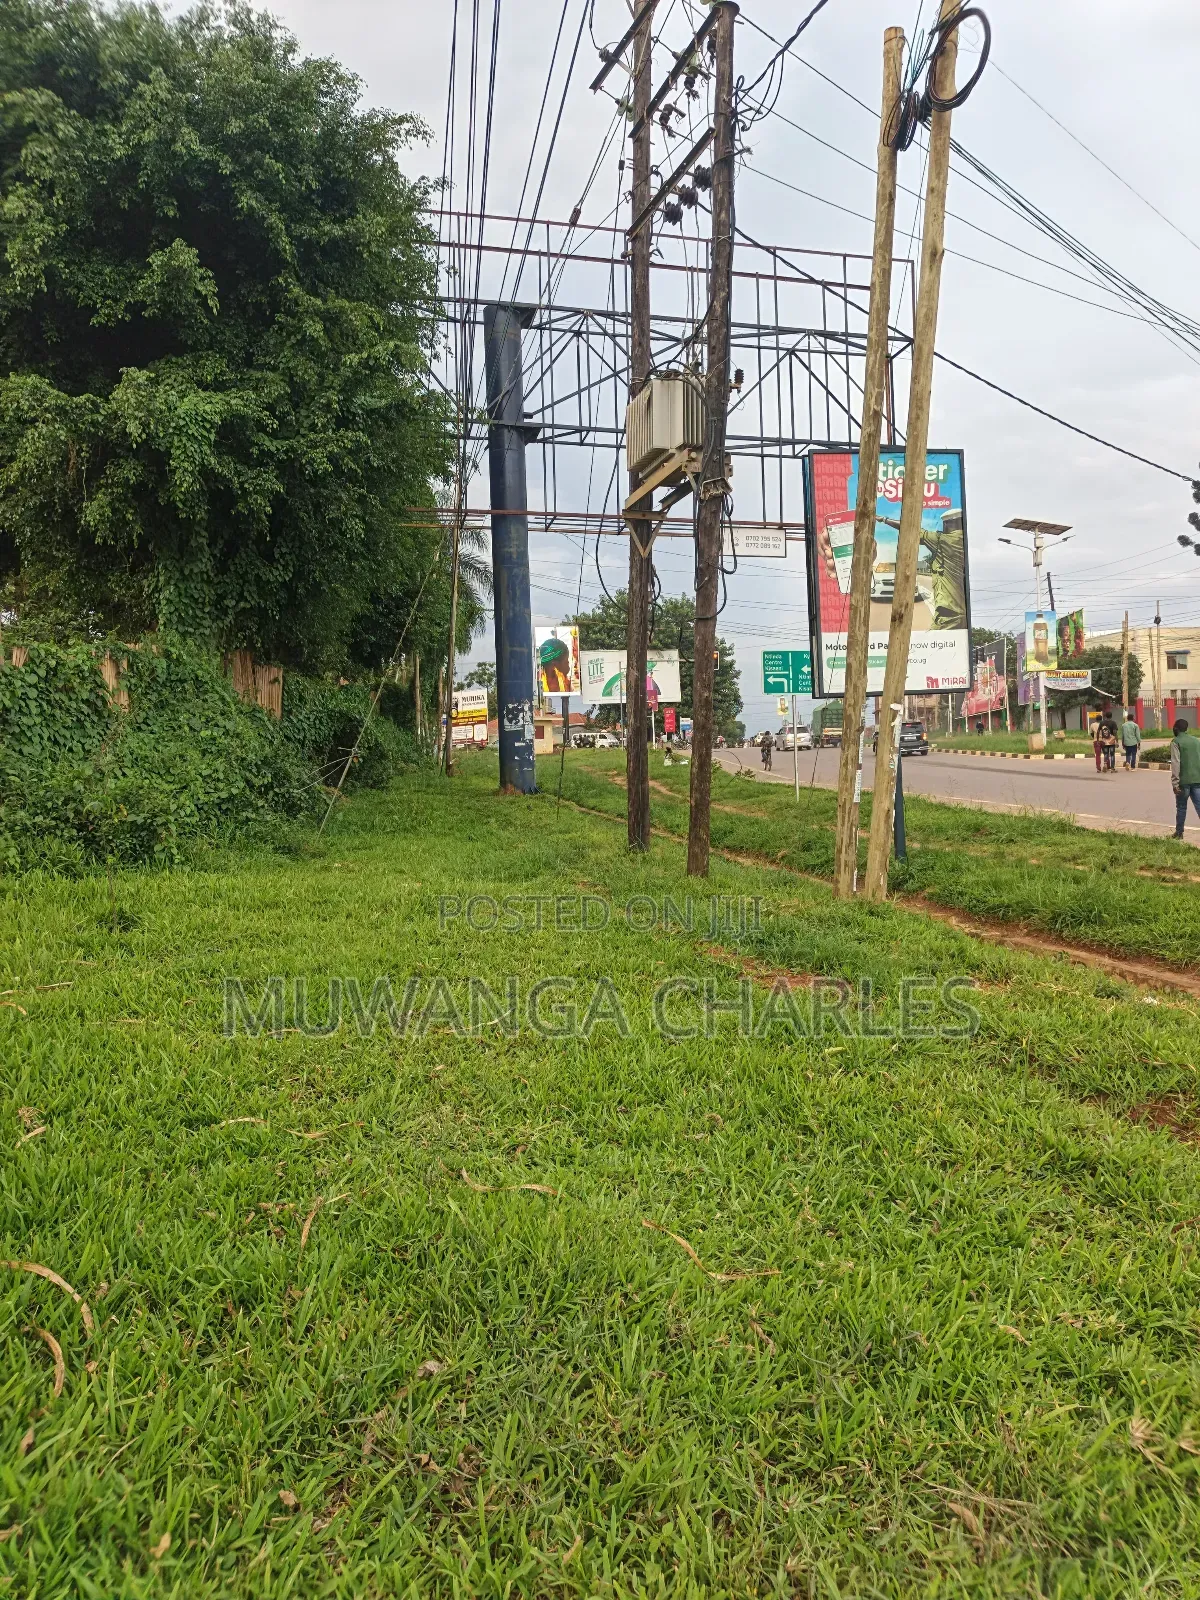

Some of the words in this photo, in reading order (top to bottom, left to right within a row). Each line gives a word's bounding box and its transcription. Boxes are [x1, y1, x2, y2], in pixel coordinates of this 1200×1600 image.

[878, 459, 948, 480] ticer
[884, 479, 935, 498] Siu
[825, 643, 848, 651] Moto
[930, 640, 956, 650] digital
